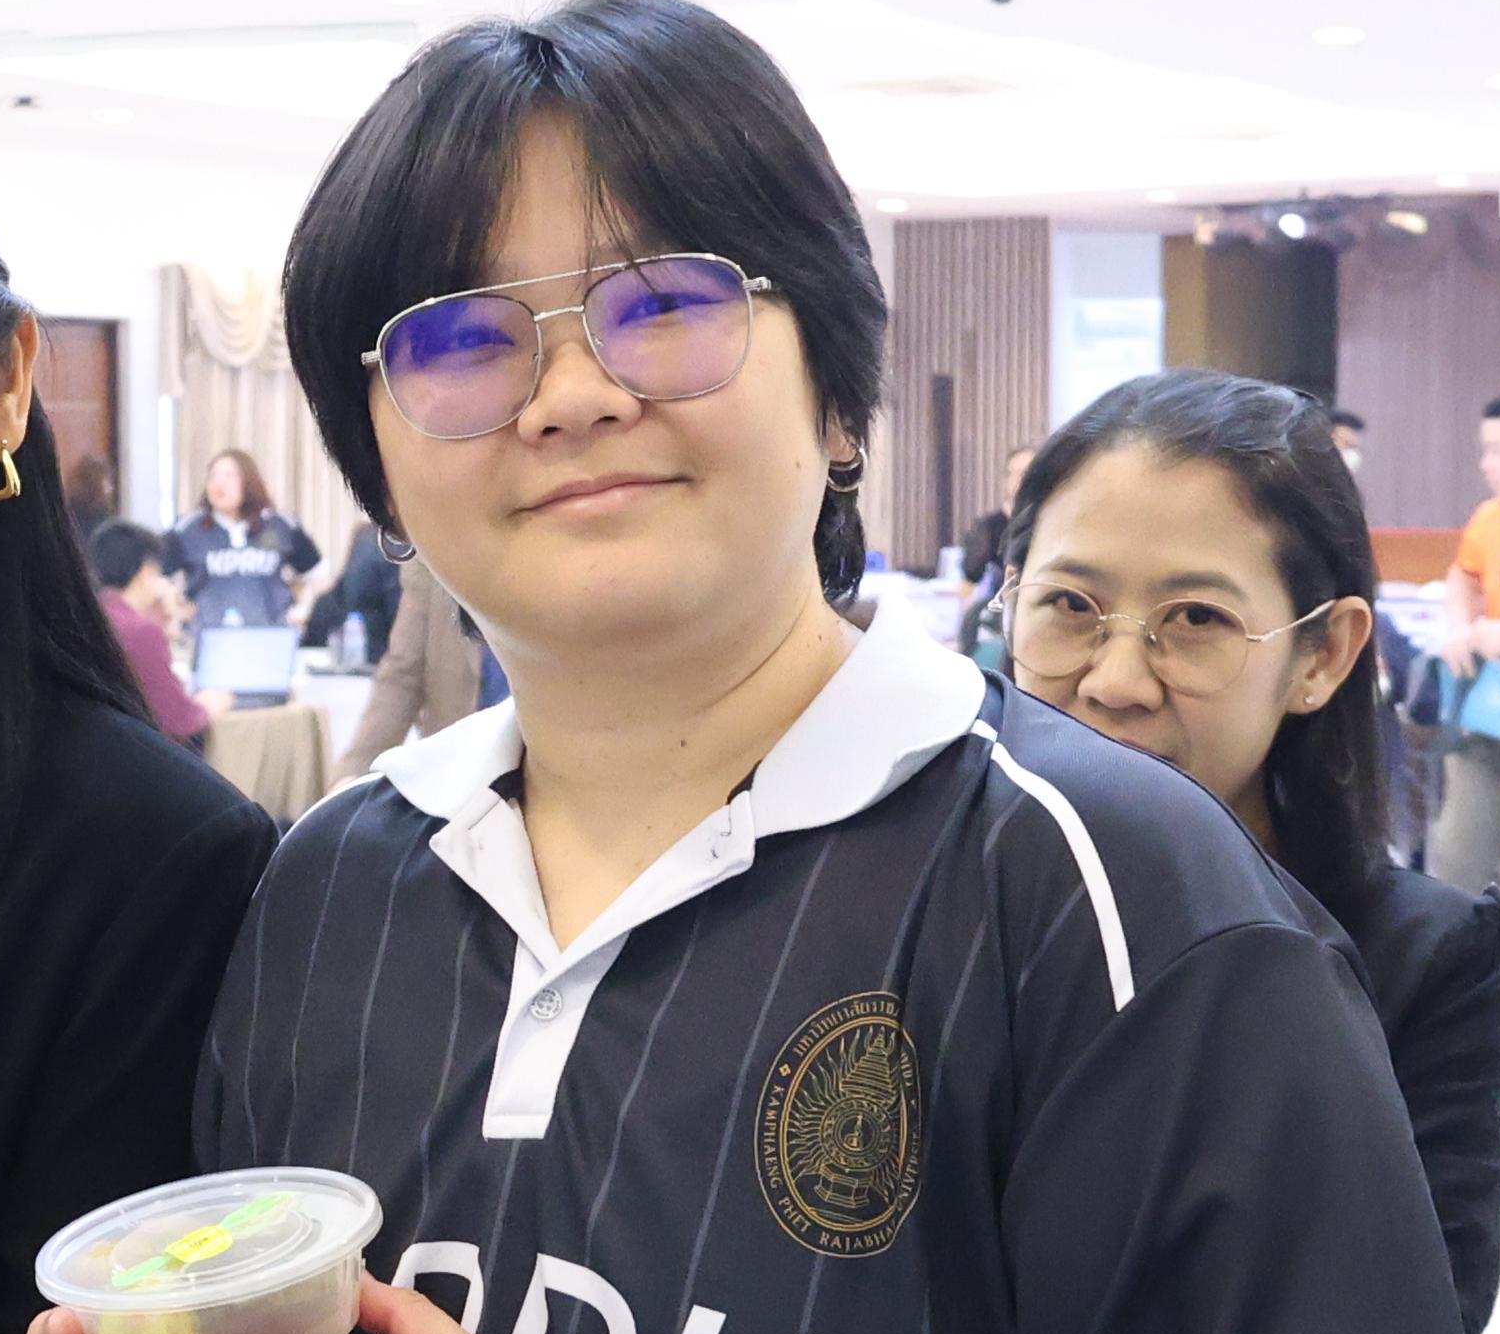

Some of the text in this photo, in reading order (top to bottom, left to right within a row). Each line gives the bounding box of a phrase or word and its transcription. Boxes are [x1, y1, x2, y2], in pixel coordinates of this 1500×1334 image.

[763, 1085, 785, 1189] KAMPHAENG
[778, 1196, 810, 1233] PHET
[819, 1224, 896, 1251] RAJABHA
